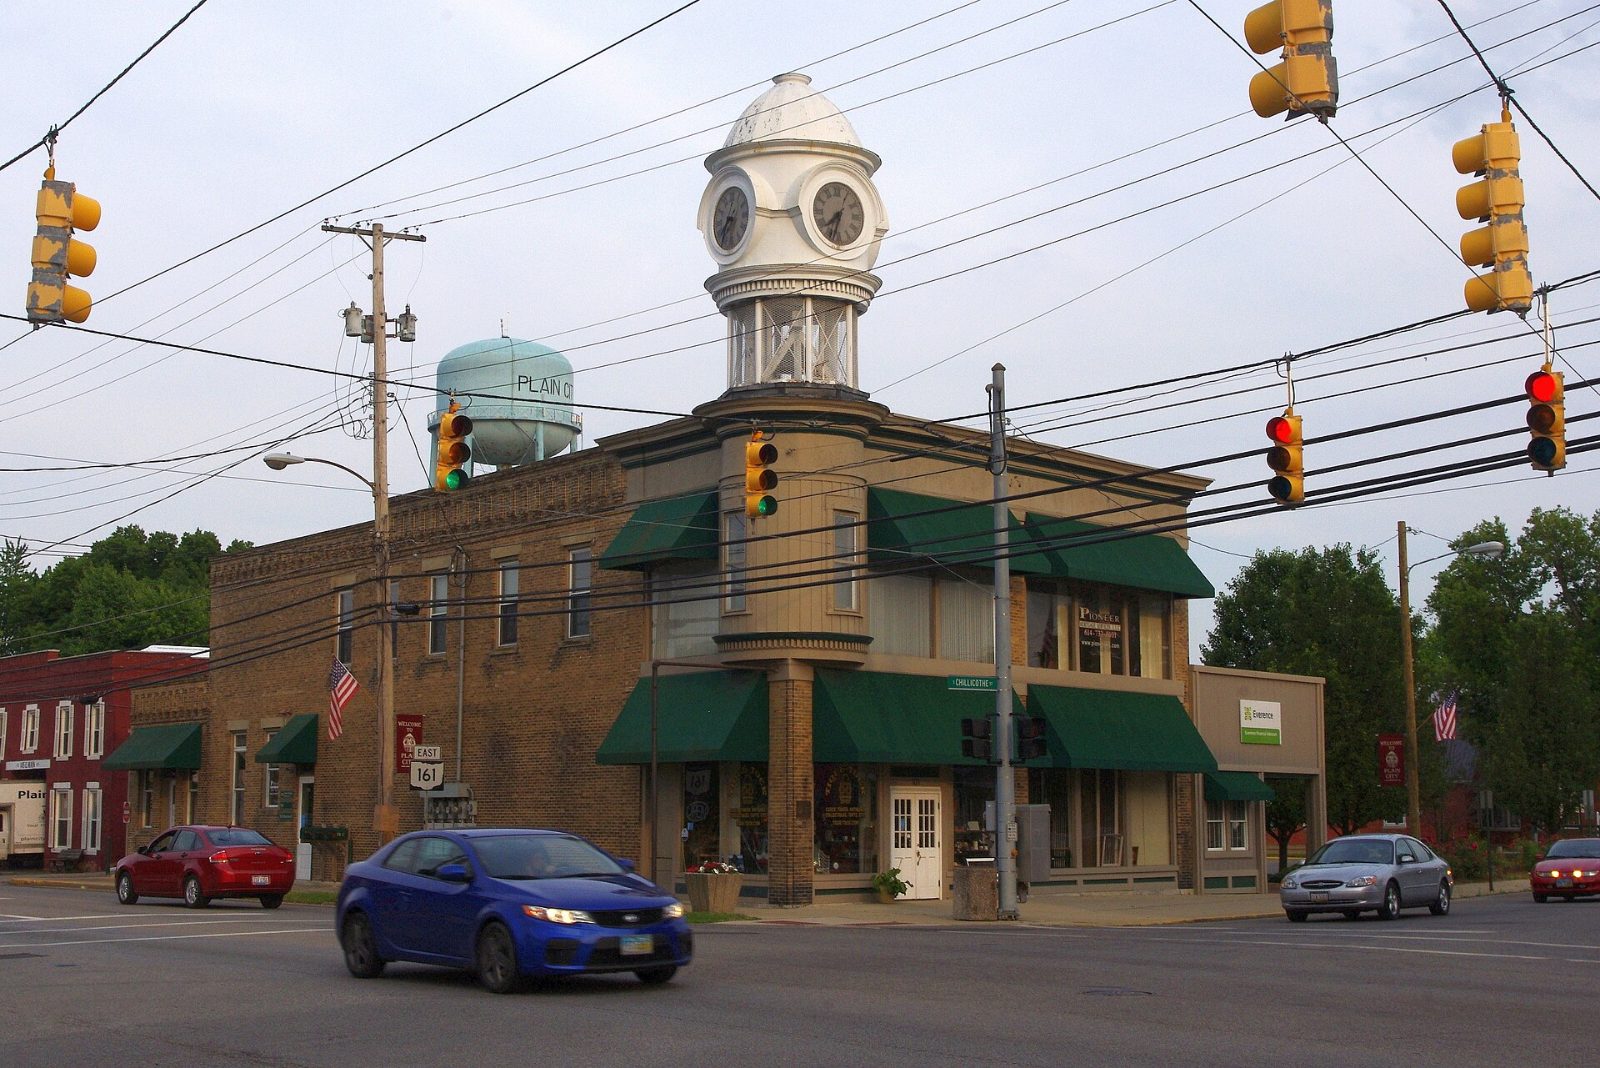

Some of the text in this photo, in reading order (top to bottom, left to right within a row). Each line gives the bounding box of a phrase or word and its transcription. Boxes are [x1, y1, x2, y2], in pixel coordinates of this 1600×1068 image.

[518, 375, 560, 396] PLAIN
[1079, 606, 1120, 623] PIONEER
[955, 678, 989, 688] CHILLICOTHE
[1252, 709, 1274, 720] Everence
[417, 748, 437, 758] EAST
[417, 767, 436, 782] 161
